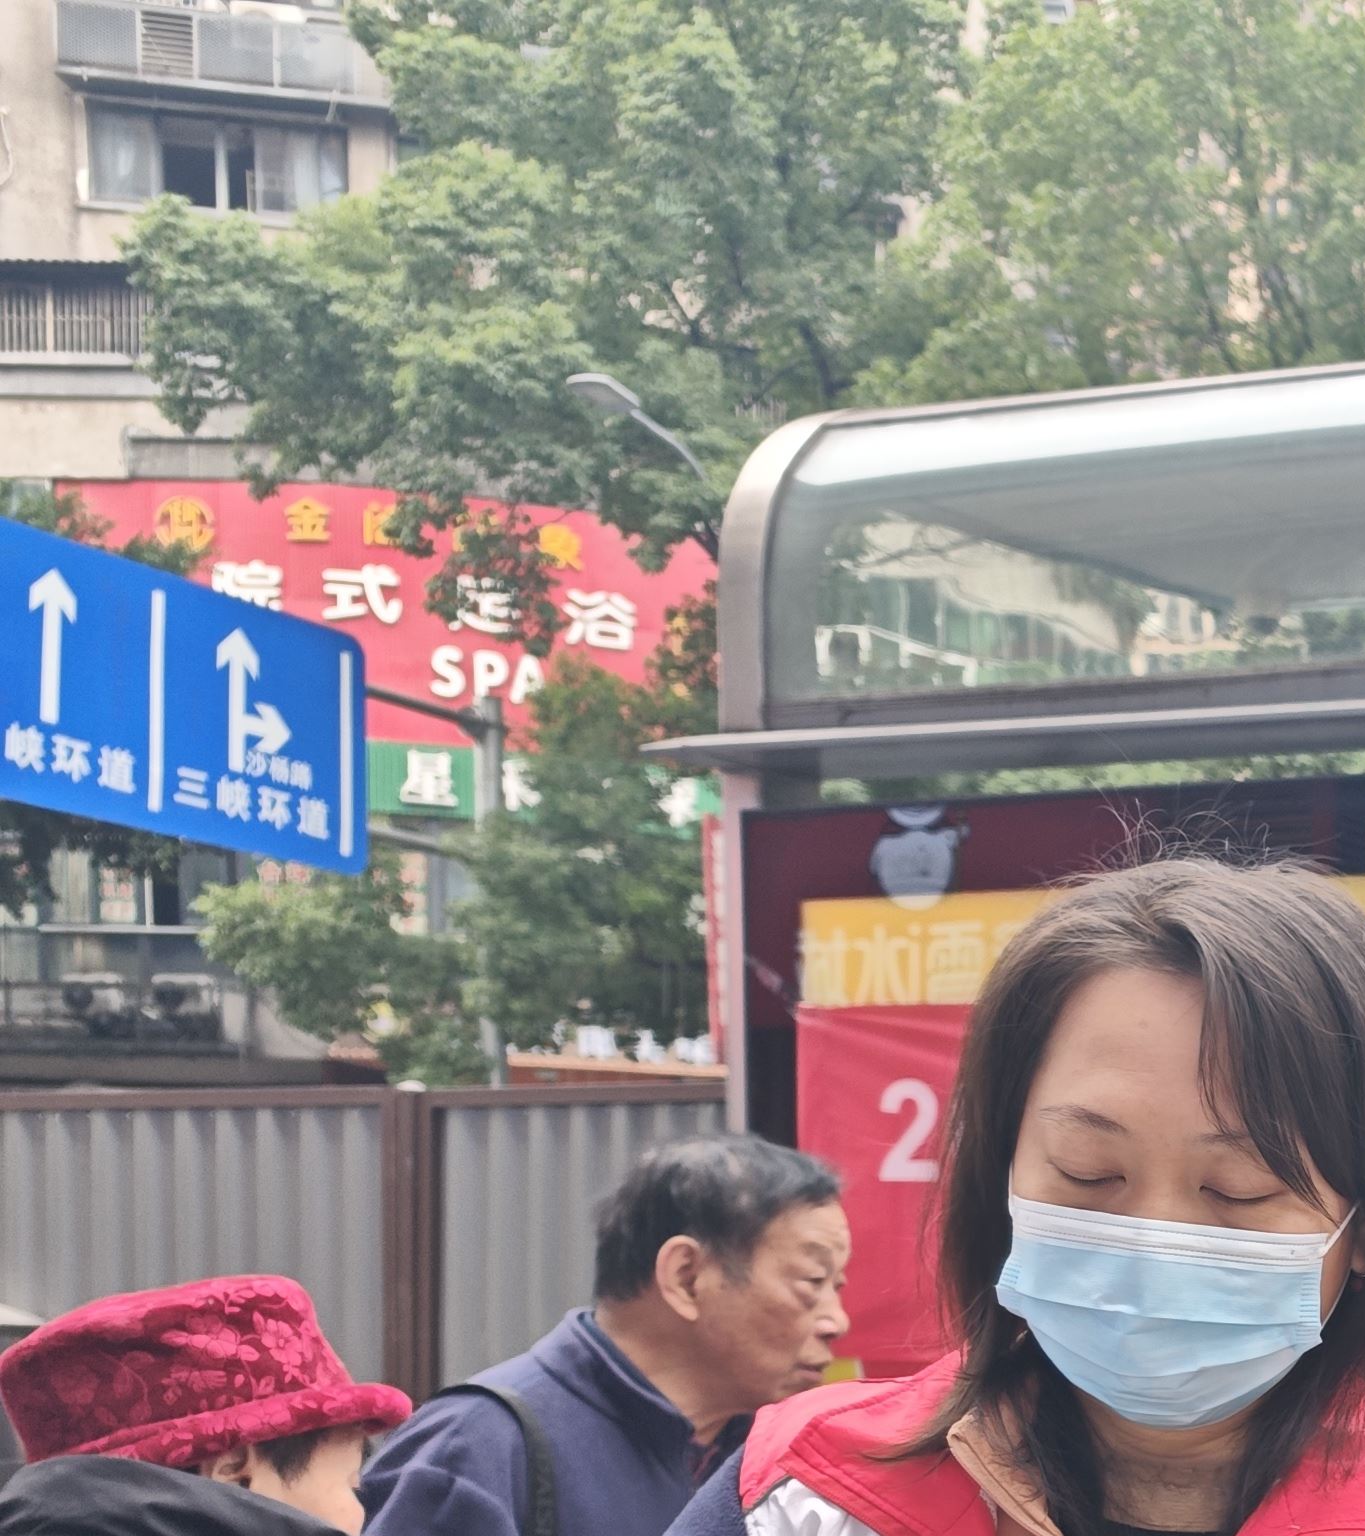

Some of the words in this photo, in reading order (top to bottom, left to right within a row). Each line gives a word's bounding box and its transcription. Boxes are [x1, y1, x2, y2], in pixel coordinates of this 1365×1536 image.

[430, 643, 546, 705] SPA
[5, 720, 136, 794] 峡环道
[174, 765, 330, 840] 三峡环道
